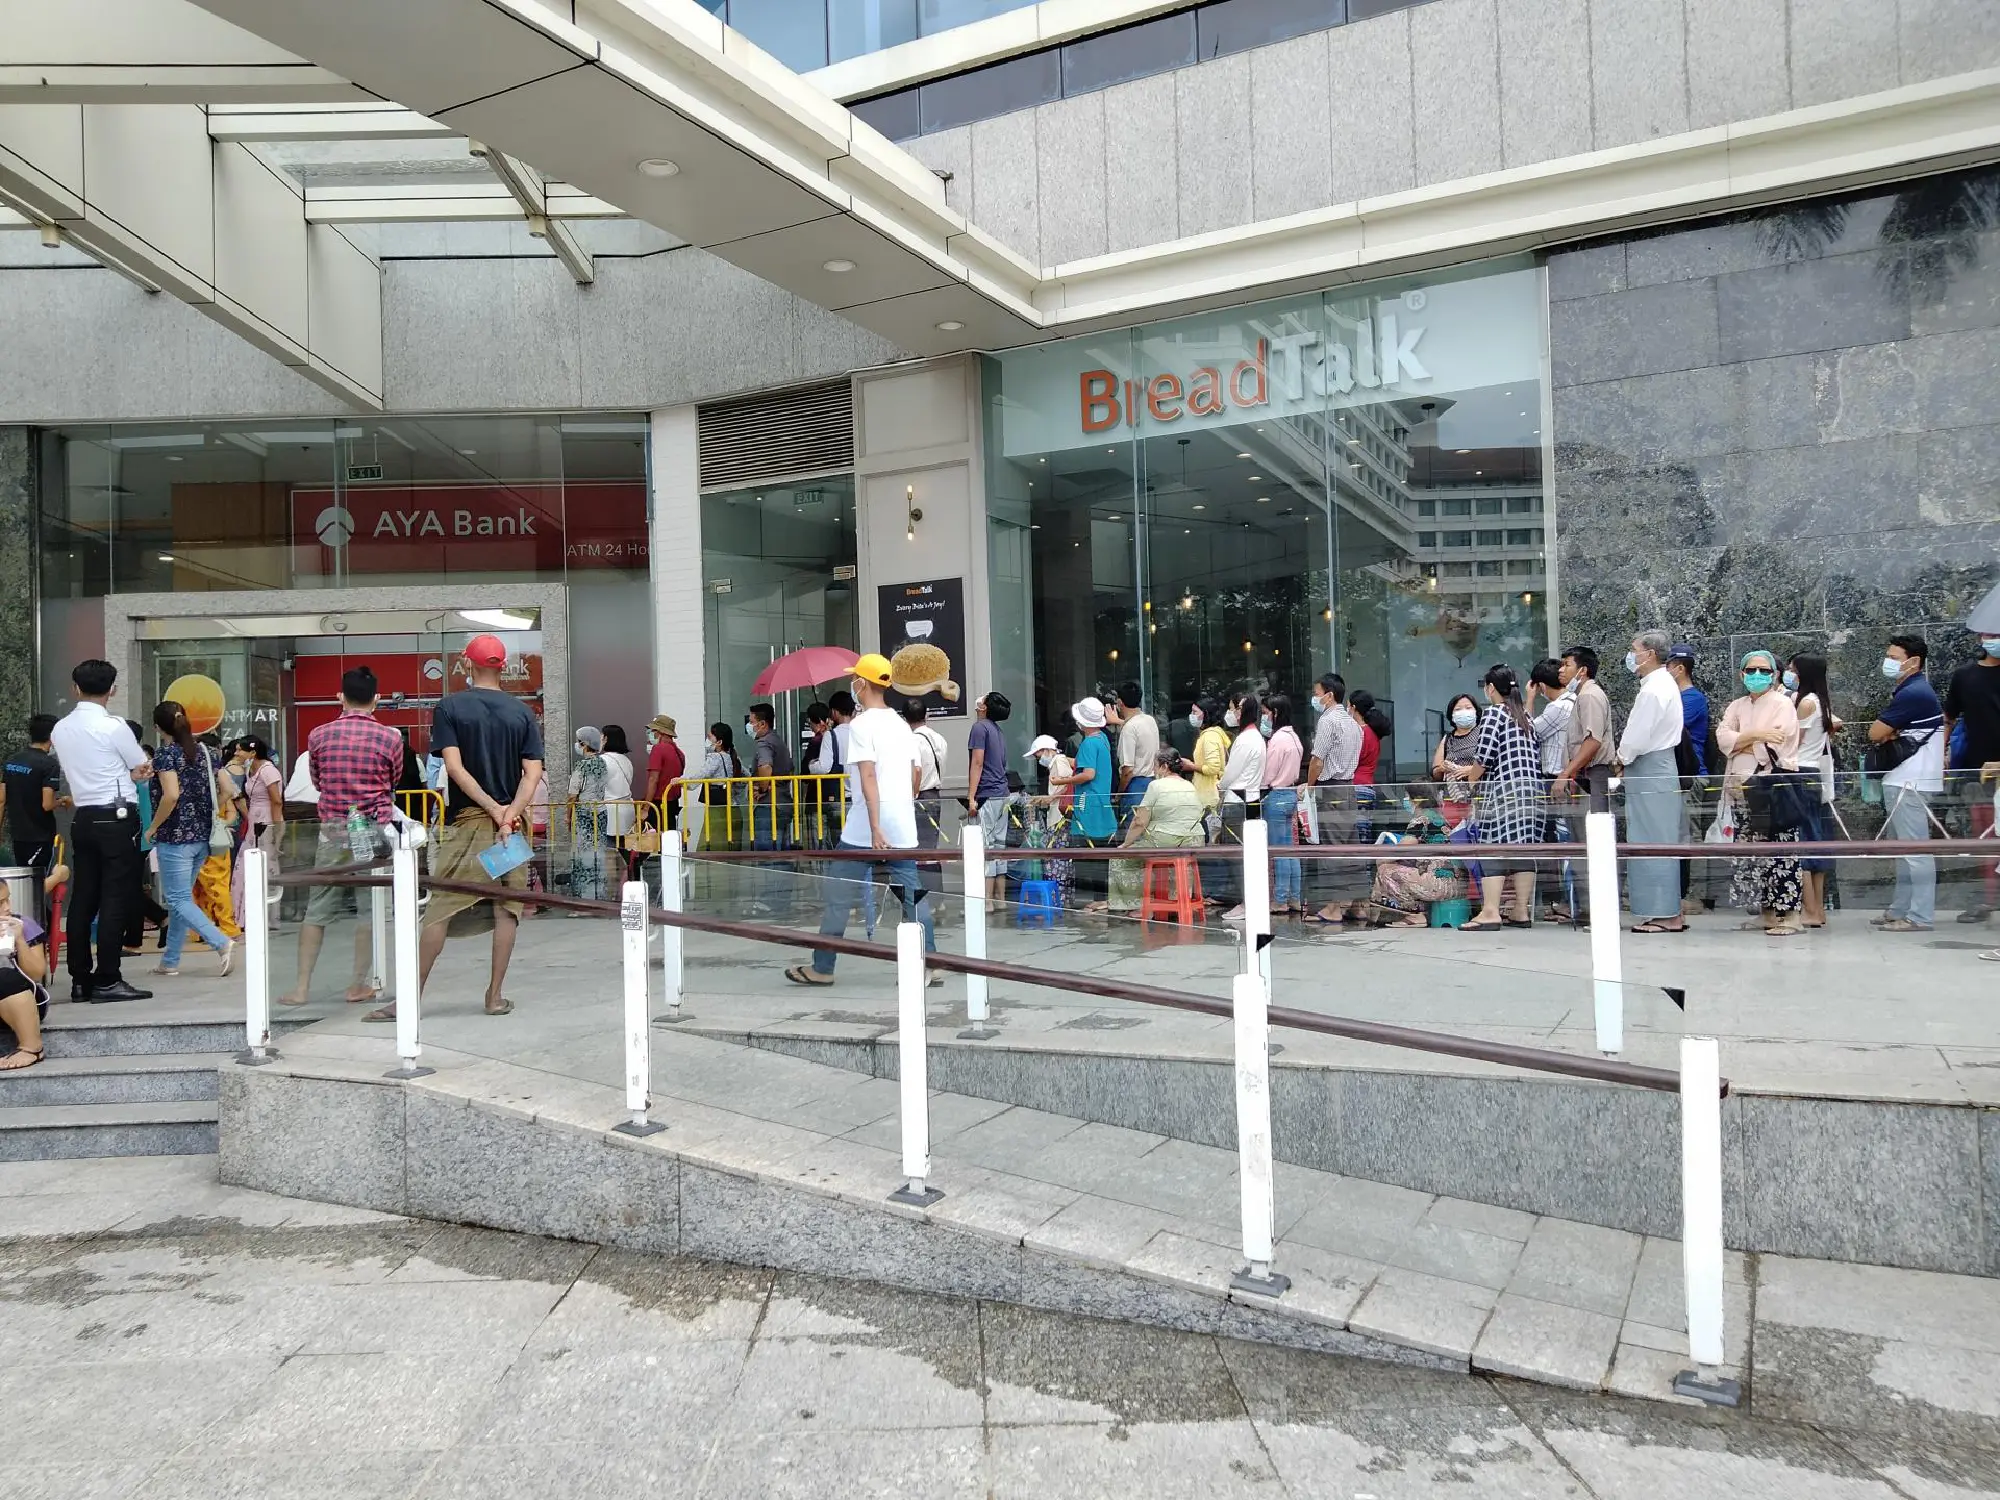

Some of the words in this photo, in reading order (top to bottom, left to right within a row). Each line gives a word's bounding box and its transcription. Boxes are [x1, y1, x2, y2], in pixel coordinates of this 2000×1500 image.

[1080, 313, 1434, 433] BreadTalk
[797, 491, 820, 504] EXIT
[373, 510, 446, 538] AYA
[454, 507, 537, 536] Bank
[567, 544, 600, 557] ATM
[605, 543, 623, 556] 24
